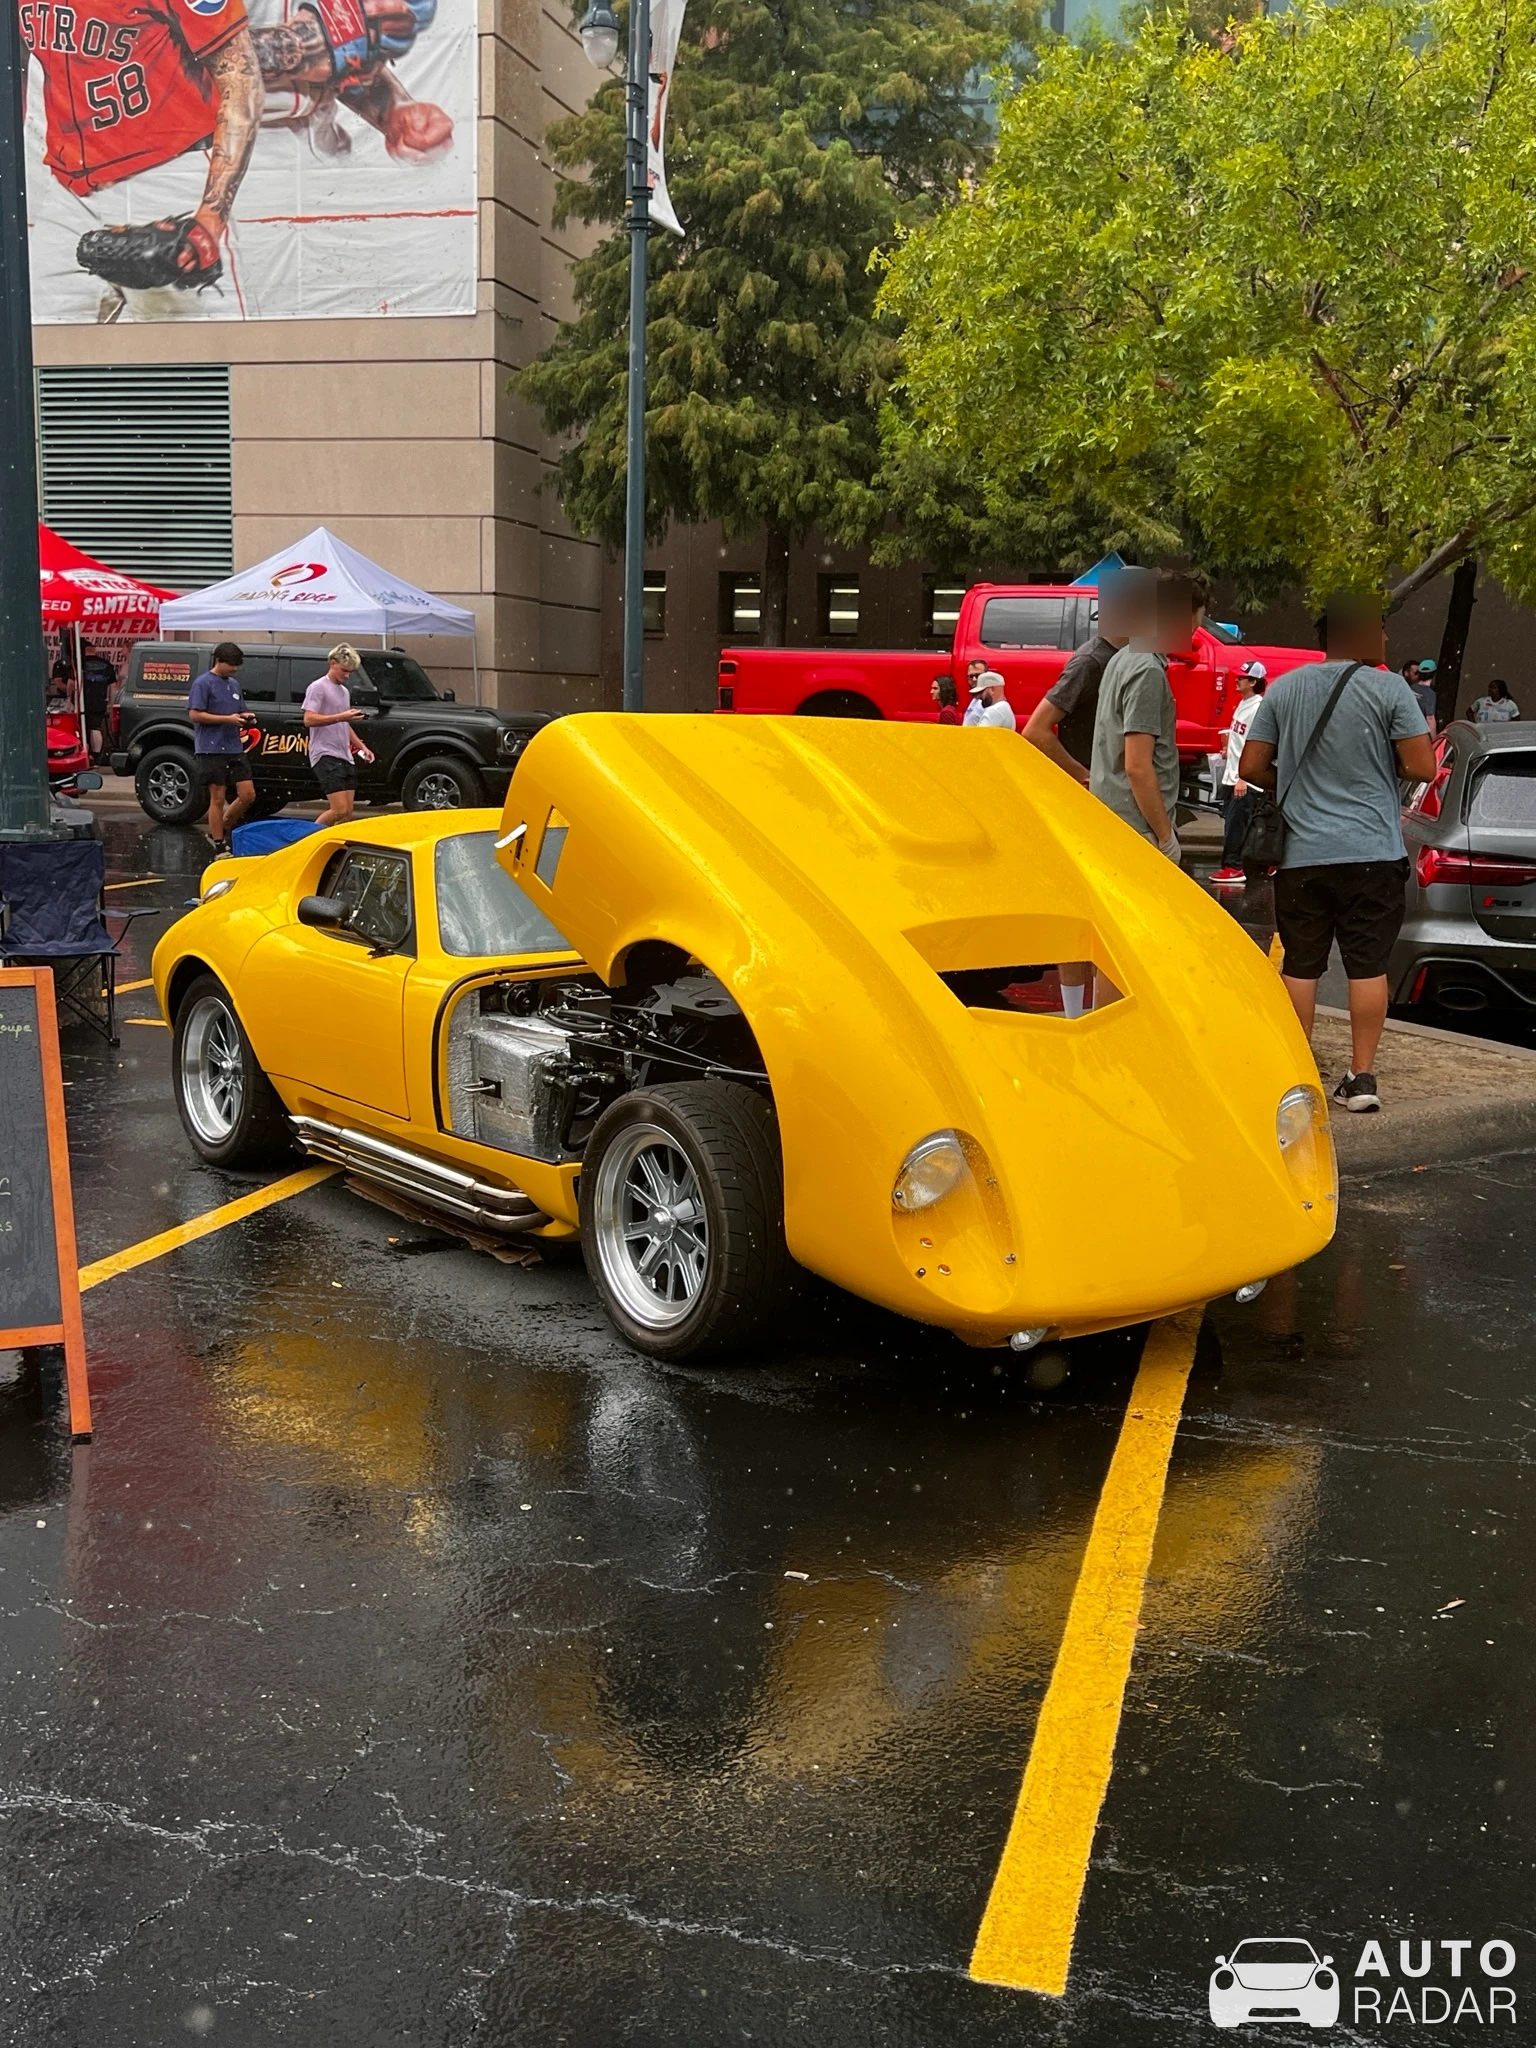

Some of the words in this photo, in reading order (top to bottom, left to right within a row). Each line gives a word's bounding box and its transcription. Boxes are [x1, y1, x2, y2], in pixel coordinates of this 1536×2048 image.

[85, 61, 151, 132] 58
[289, 592, 338, 605] EDGE
[0, 1024, 33, 1038] oupe
